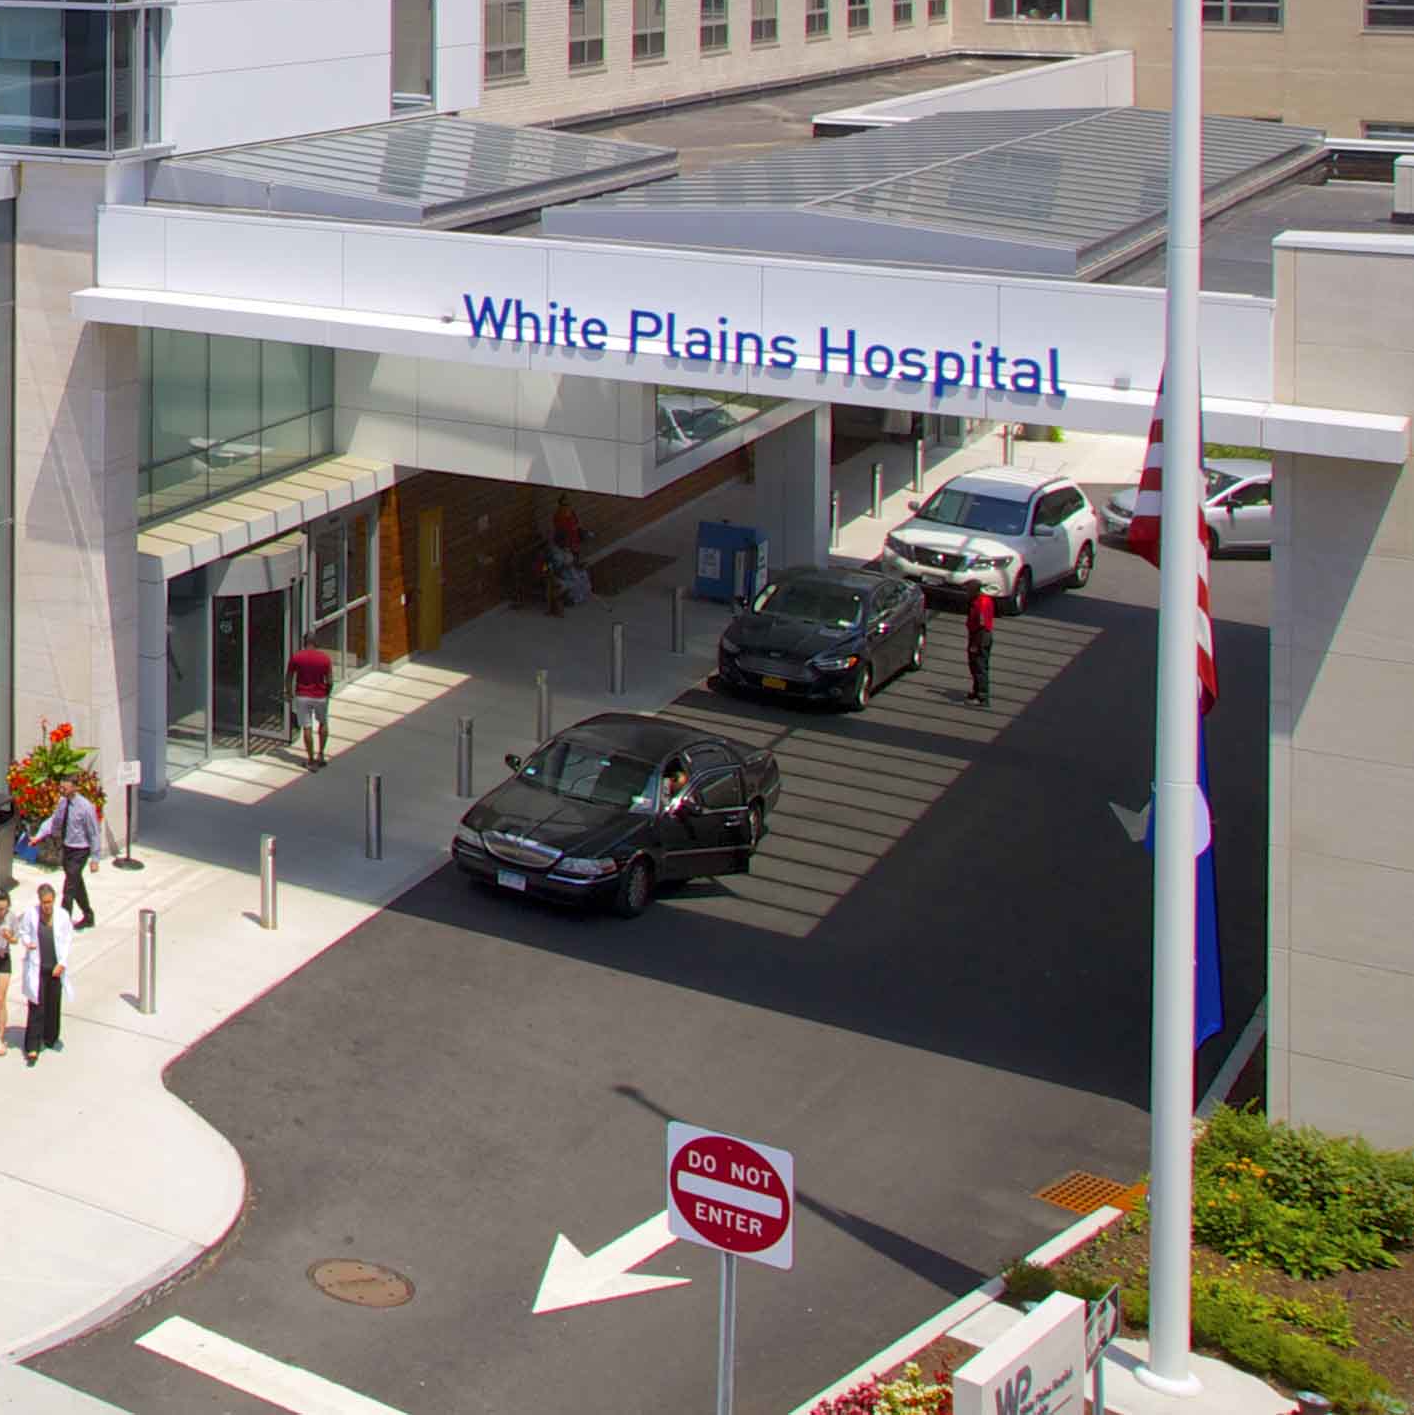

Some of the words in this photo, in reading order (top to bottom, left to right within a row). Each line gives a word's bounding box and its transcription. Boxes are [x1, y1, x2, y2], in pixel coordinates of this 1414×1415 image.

[463, 293, 608, 351] White
[629, 308, 797, 370] Plains
[820, 326, 1066, 397] Hospital
[688, 1150, 717, 1173] DO
[730, 1162, 772, 1189] NOT
[695, 1201, 763, 1238] ENTER
